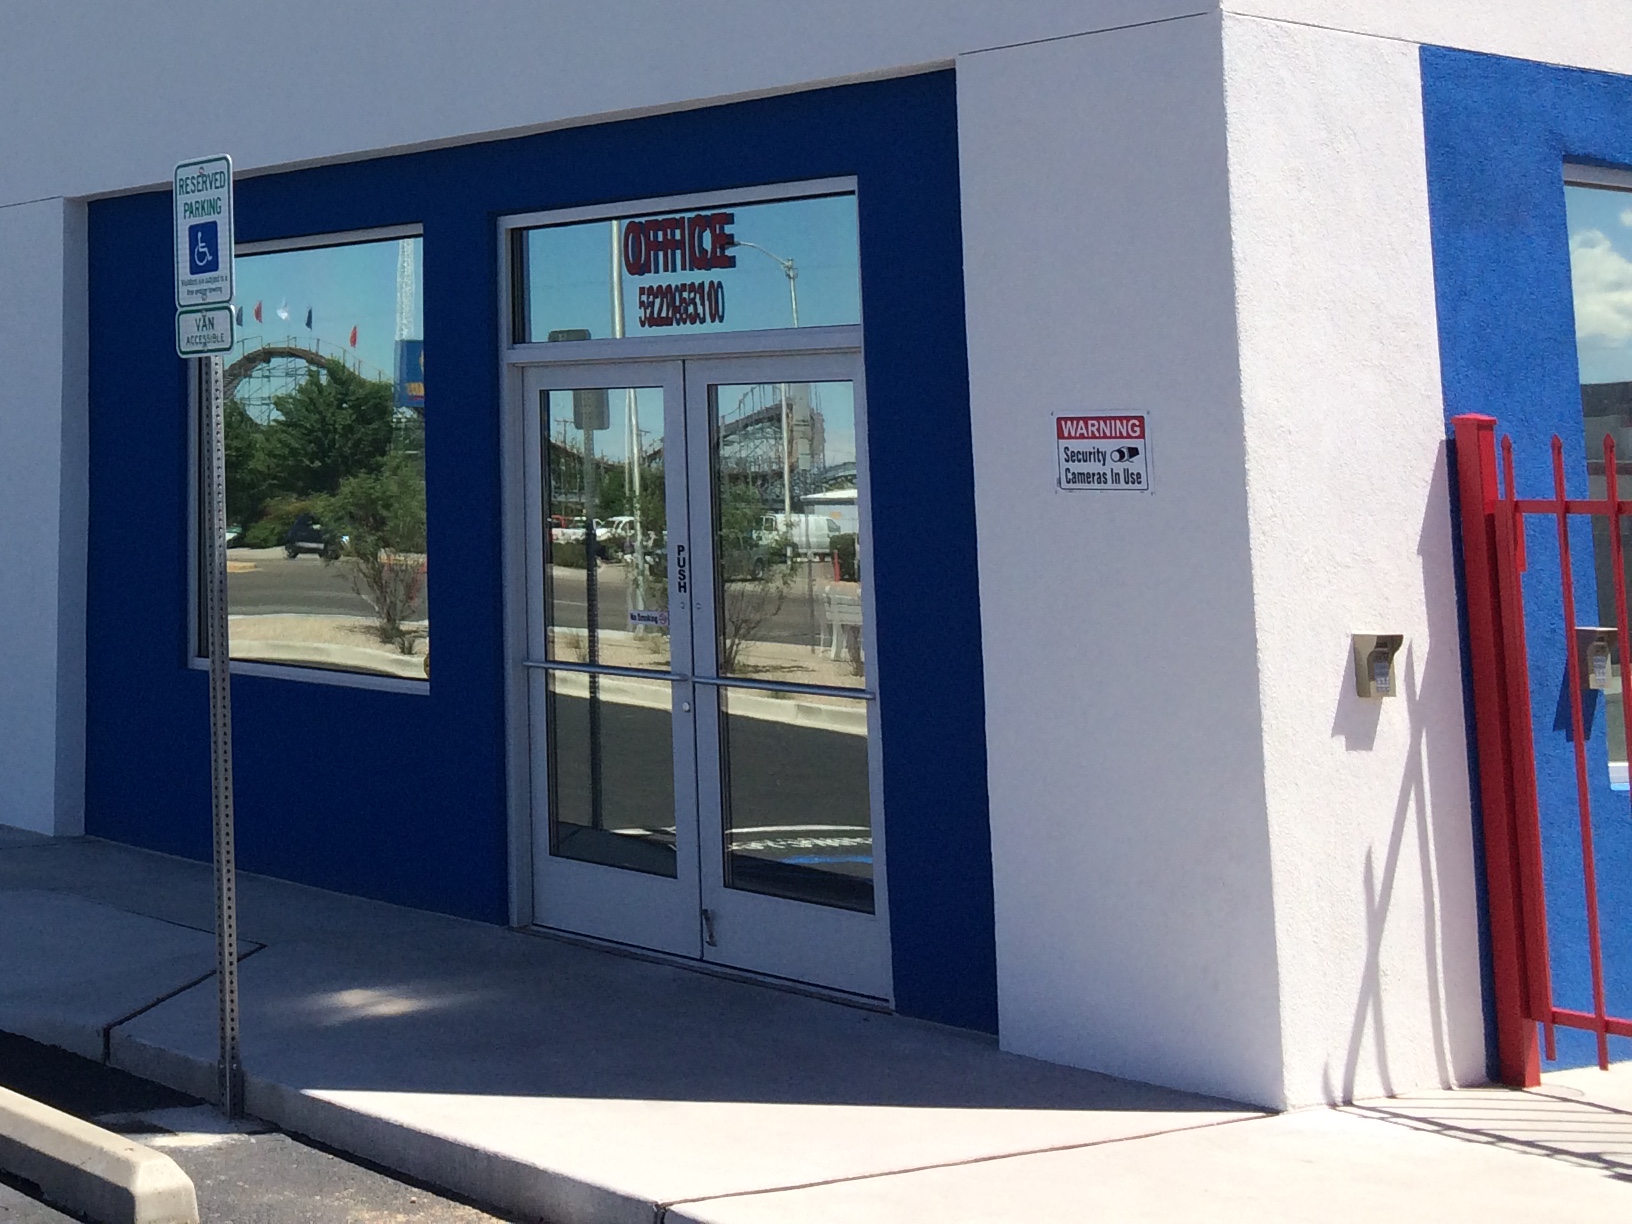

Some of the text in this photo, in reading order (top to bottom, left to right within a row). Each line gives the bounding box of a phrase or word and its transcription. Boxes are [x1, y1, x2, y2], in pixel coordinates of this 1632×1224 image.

[178, 170, 226, 196] RESERVED
[183, 196, 222, 220] PARKING
[623, 212, 737, 276] OFFICE
[195, 316, 215, 332] VAN
[185, 332, 225, 346] ACCESSIBLE
[1060, 419, 1141, 438] WARNING
[1063, 446, 1107, 466] Security
[1065, 467, 1143, 485] Cameras In Use
[677, 544, 687, 594] PUSH
